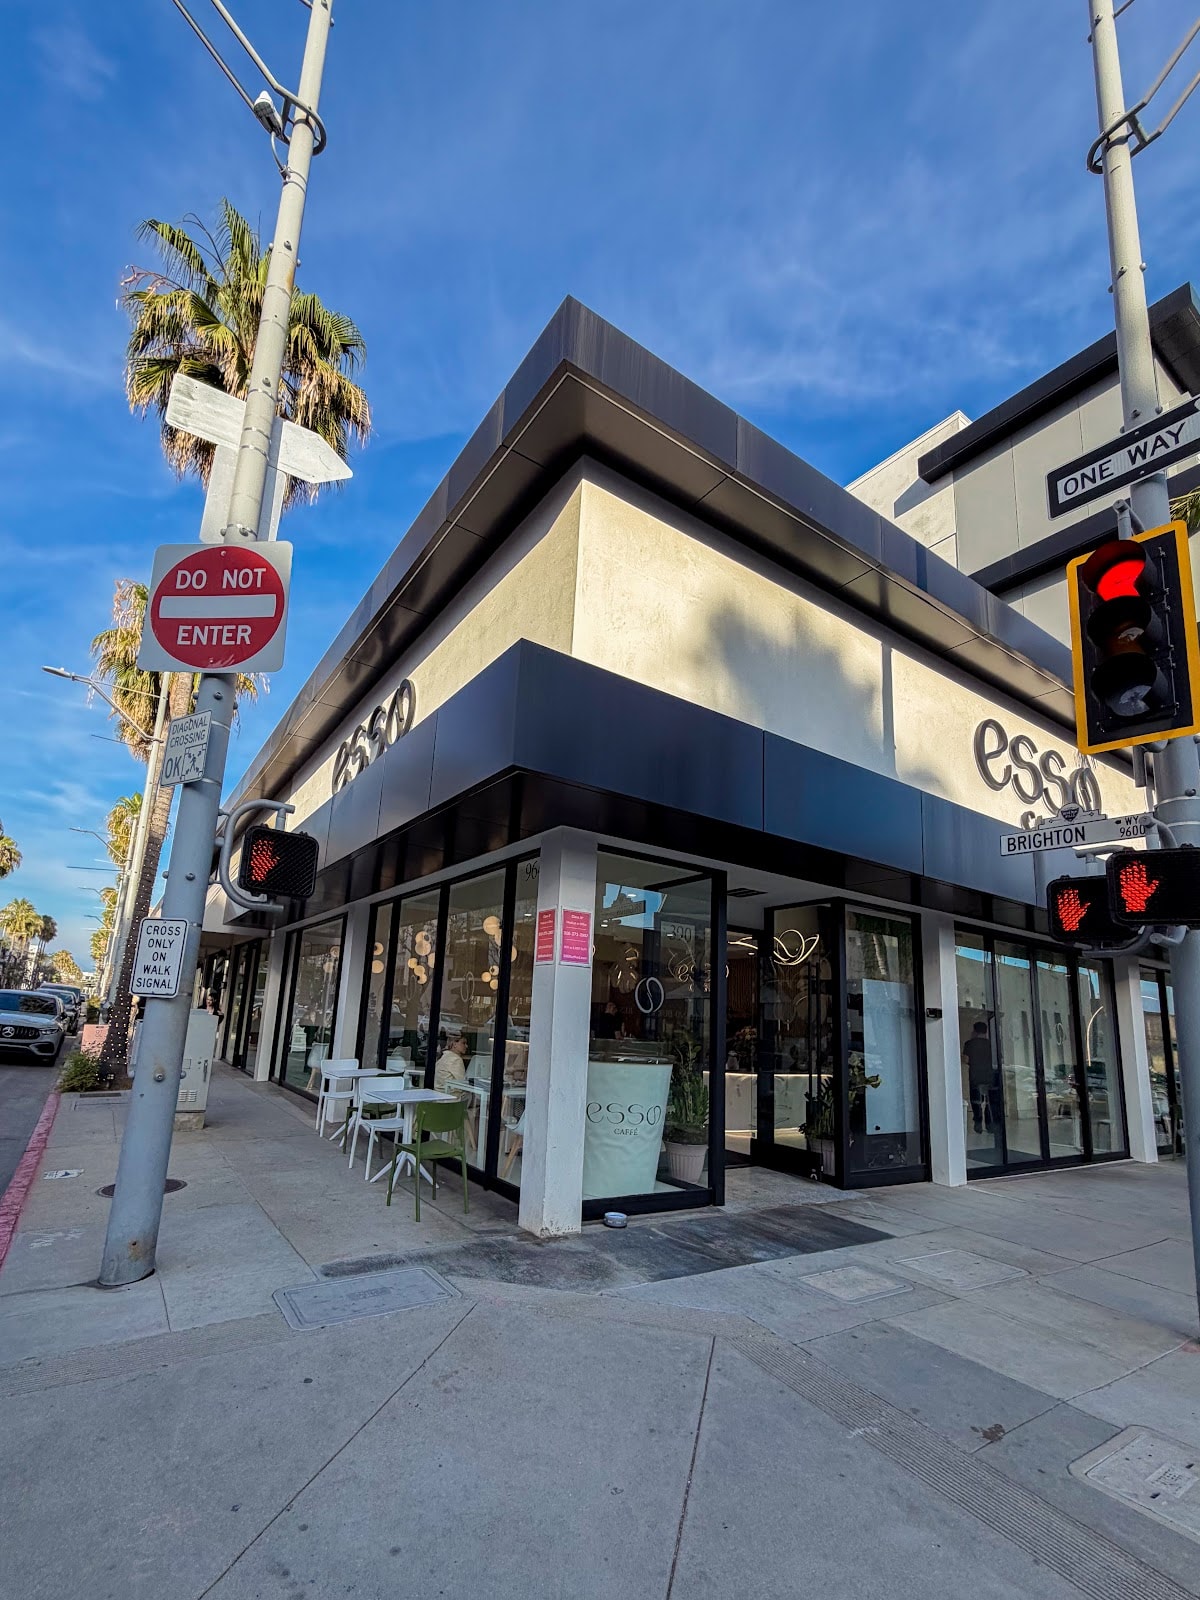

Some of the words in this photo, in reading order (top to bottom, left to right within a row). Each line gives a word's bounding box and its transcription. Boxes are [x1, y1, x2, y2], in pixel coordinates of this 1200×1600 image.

[1064, 459, 1114, 496] ONE
[1127, 422, 1186, 466] WAY
[175, 569, 207, 590] DO
[222, 568, 267, 589] NOT
[176, 624, 252, 646] ENTER
[171, 716, 208, 735] DIAGONAL
[169, 729, 206, 748] CROSSING
[165, 755, 182, 779] OK
[973, 718, 1102, 816] esso
[1007, 826, 1086, 852] BRIGHTON
[1124, 815, 1139, 826] WY
[1119, 825, 1146, 838] 9600
[525, 860, 540, 881] 96
[146, 925, 181, 936] CROSS
[147, 938, 175, 949] ONLY
[152, 951, 167, 962] ON
[143, 964, 171, 976] WALK
[135, 977, 173, 990] SIGNAL
[586, 1102, 662, 1126] esso
[613, 1127, 639, 1136] CAFFÉ
